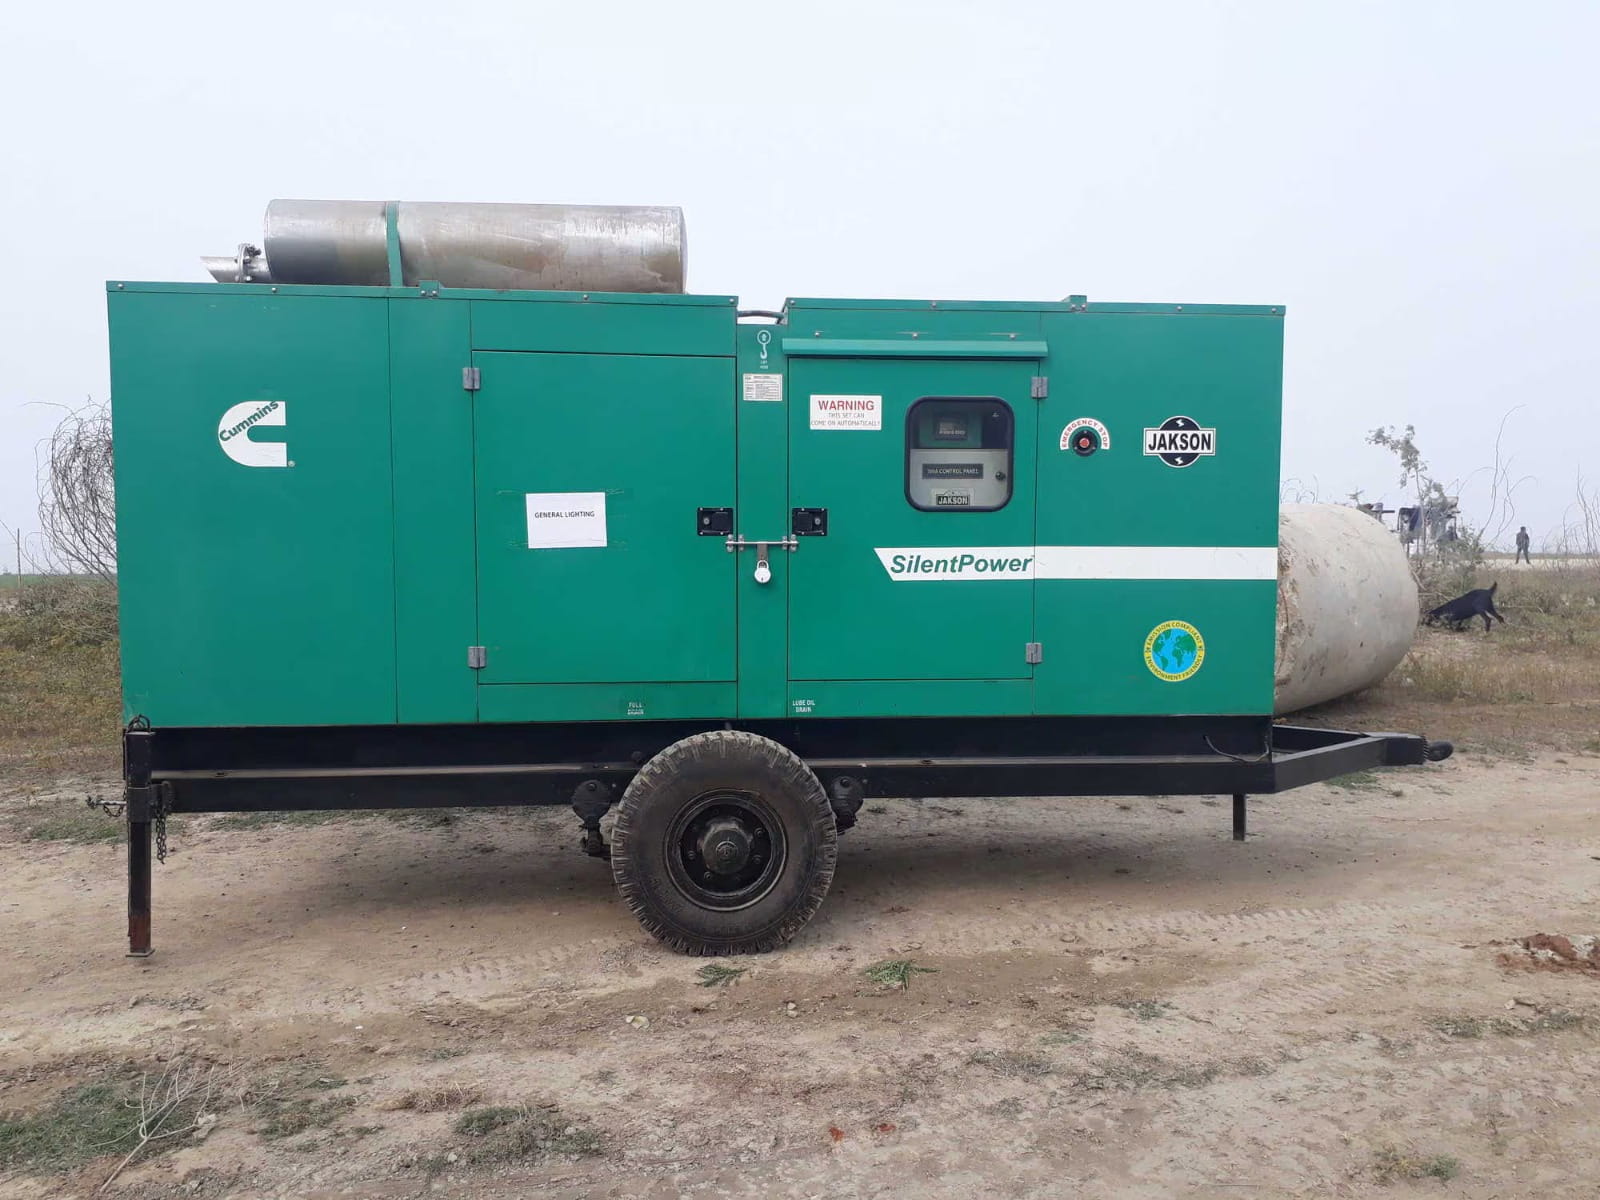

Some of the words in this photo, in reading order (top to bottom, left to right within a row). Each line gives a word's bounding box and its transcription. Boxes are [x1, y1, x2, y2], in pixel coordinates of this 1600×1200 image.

[818, 400, 874, 411] WARNING
[219, 400, 279, 441] Cummins
[1062, 419, 1098, 448] EMERGENCY
[1098, 426, 1108, 448] STOP
[1148, 432, 1212, 451] JAKSON
[938, 495, 969, 505] JAKSON
[565, 510, 595, 518] LIGHTING
[890, 554, 1033, 574] SilentPower
